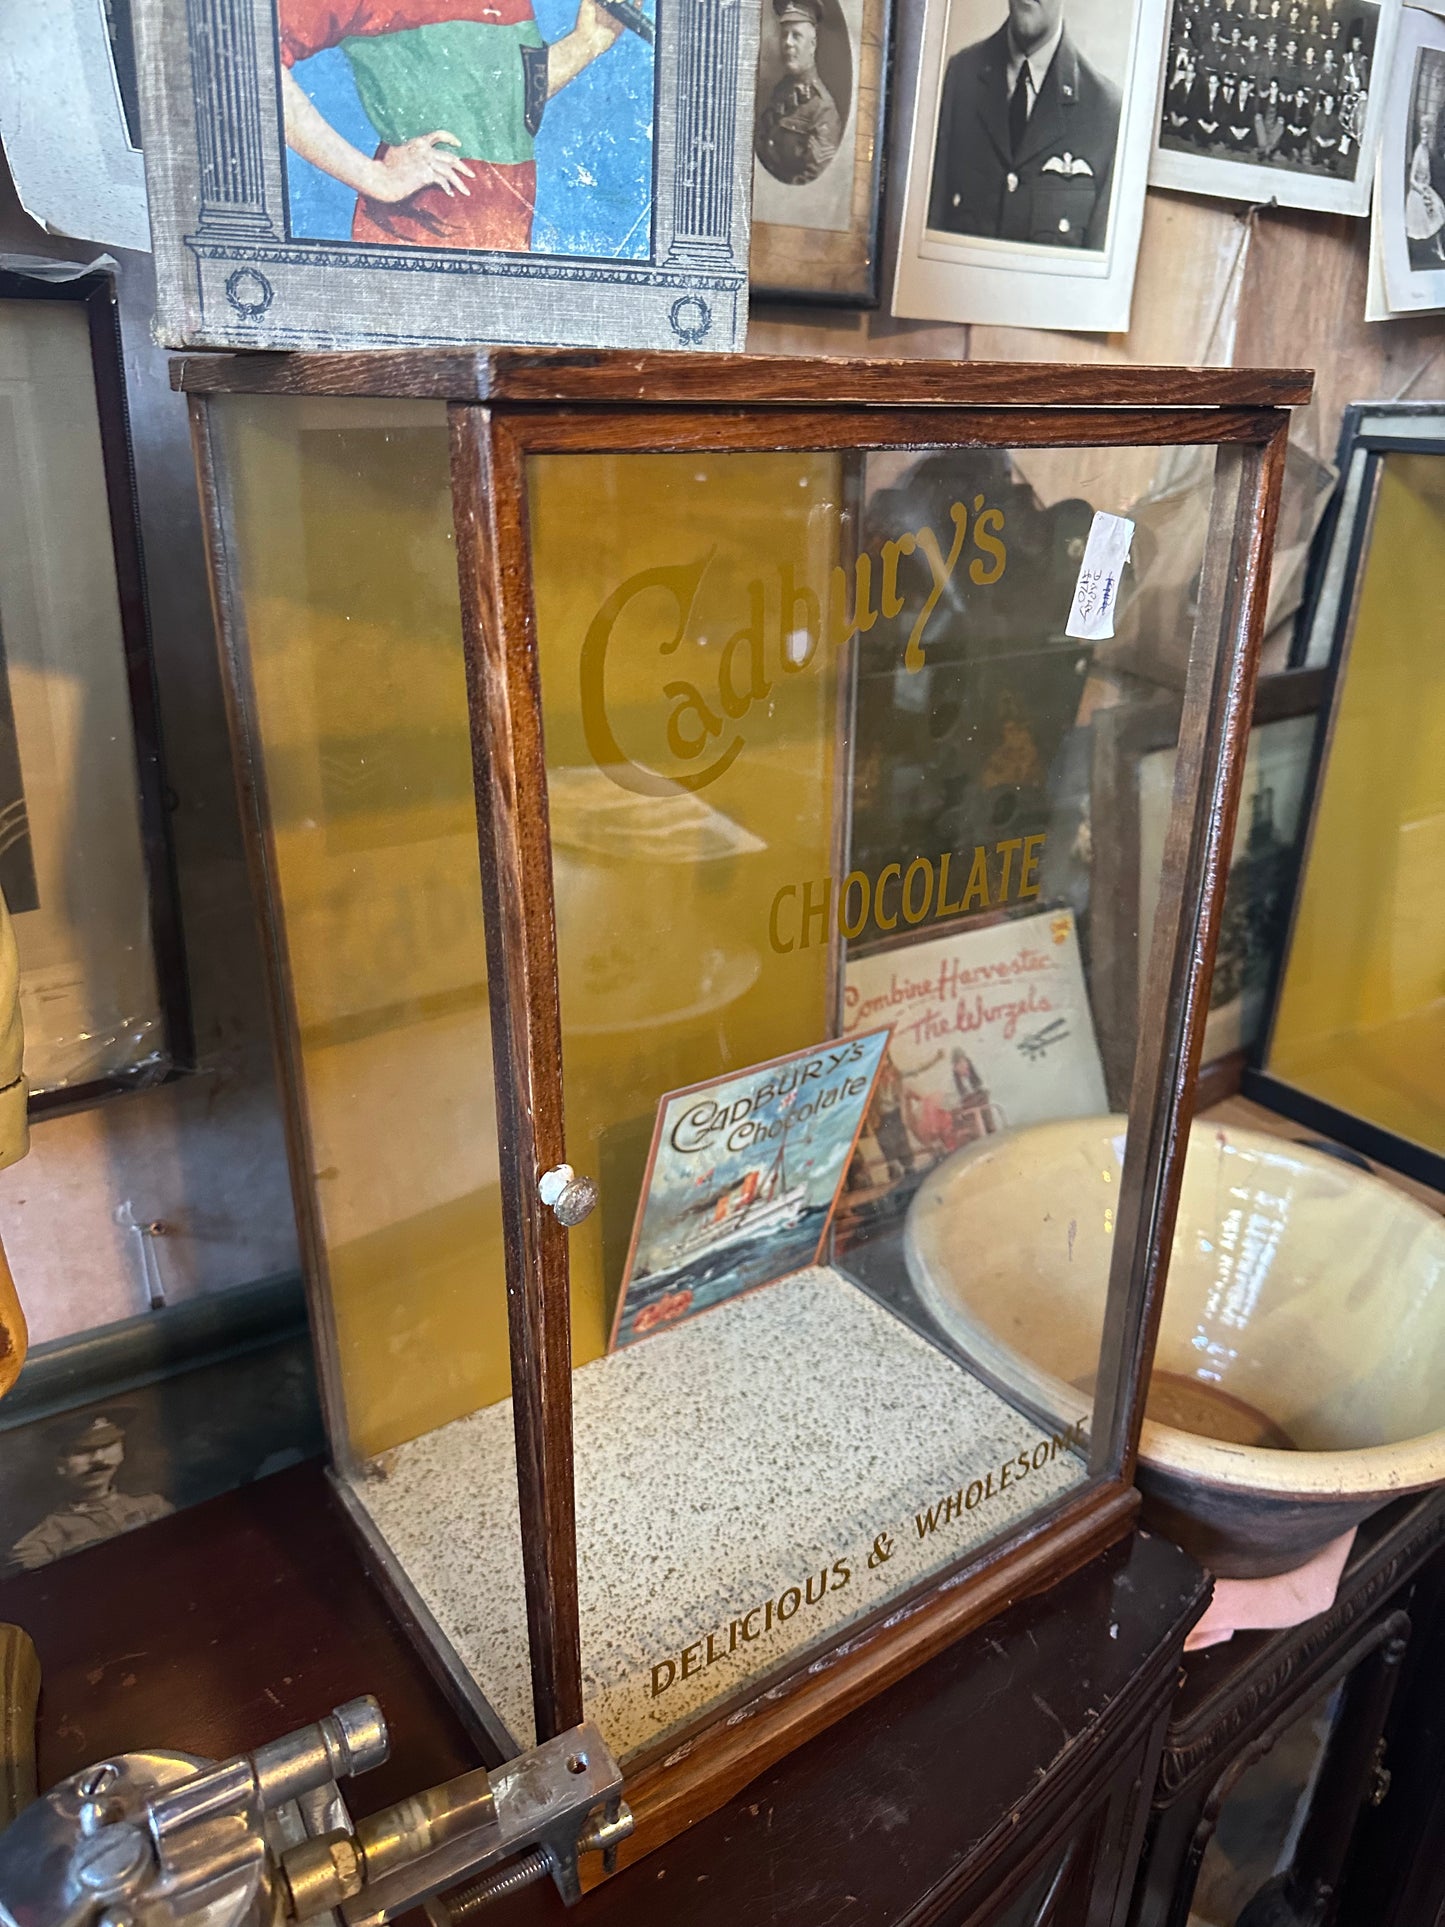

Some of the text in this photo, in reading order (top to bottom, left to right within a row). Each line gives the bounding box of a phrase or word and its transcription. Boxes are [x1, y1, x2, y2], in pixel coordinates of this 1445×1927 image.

[580, 494, 1006, 797] Cadbury's
[769, 834, 1046, 954] CHOCOLATE
[902, 1008, 950, 1044] The
[651, 1416, 1089, 1698] DELICIOUS & WHOLESOME
